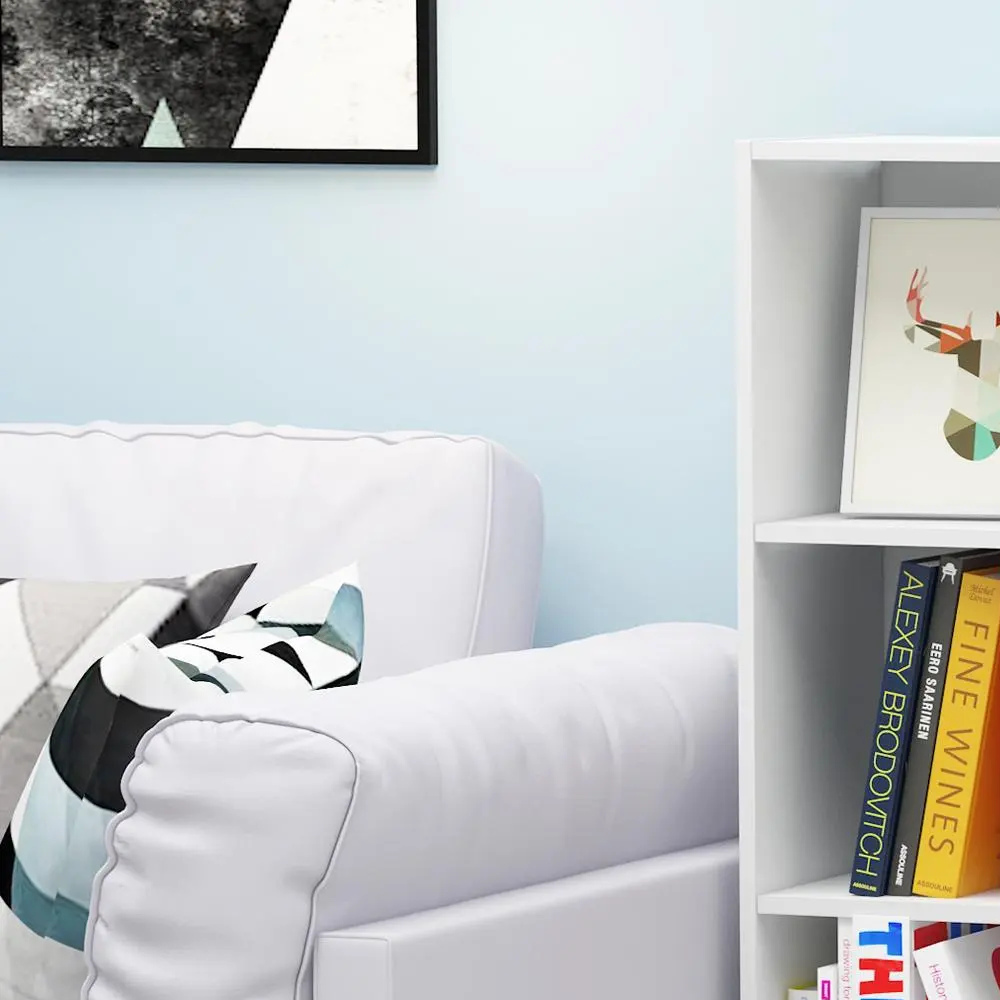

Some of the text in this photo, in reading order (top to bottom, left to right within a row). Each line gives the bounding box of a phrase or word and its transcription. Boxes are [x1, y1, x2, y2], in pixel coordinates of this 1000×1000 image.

[917, 642, 943, 740] EERO SAARINEN
[952, 620, 989, 709] FINE
[856, 570, 924, 876] ALEXEY BRODOVITCH
[928, 729, 973, 856] WINES
[895, 844, 908, 886] ASSOULINE
[916, 879, 953, 893] ASSOULINE
[841, 939, 851, 983] drawing
